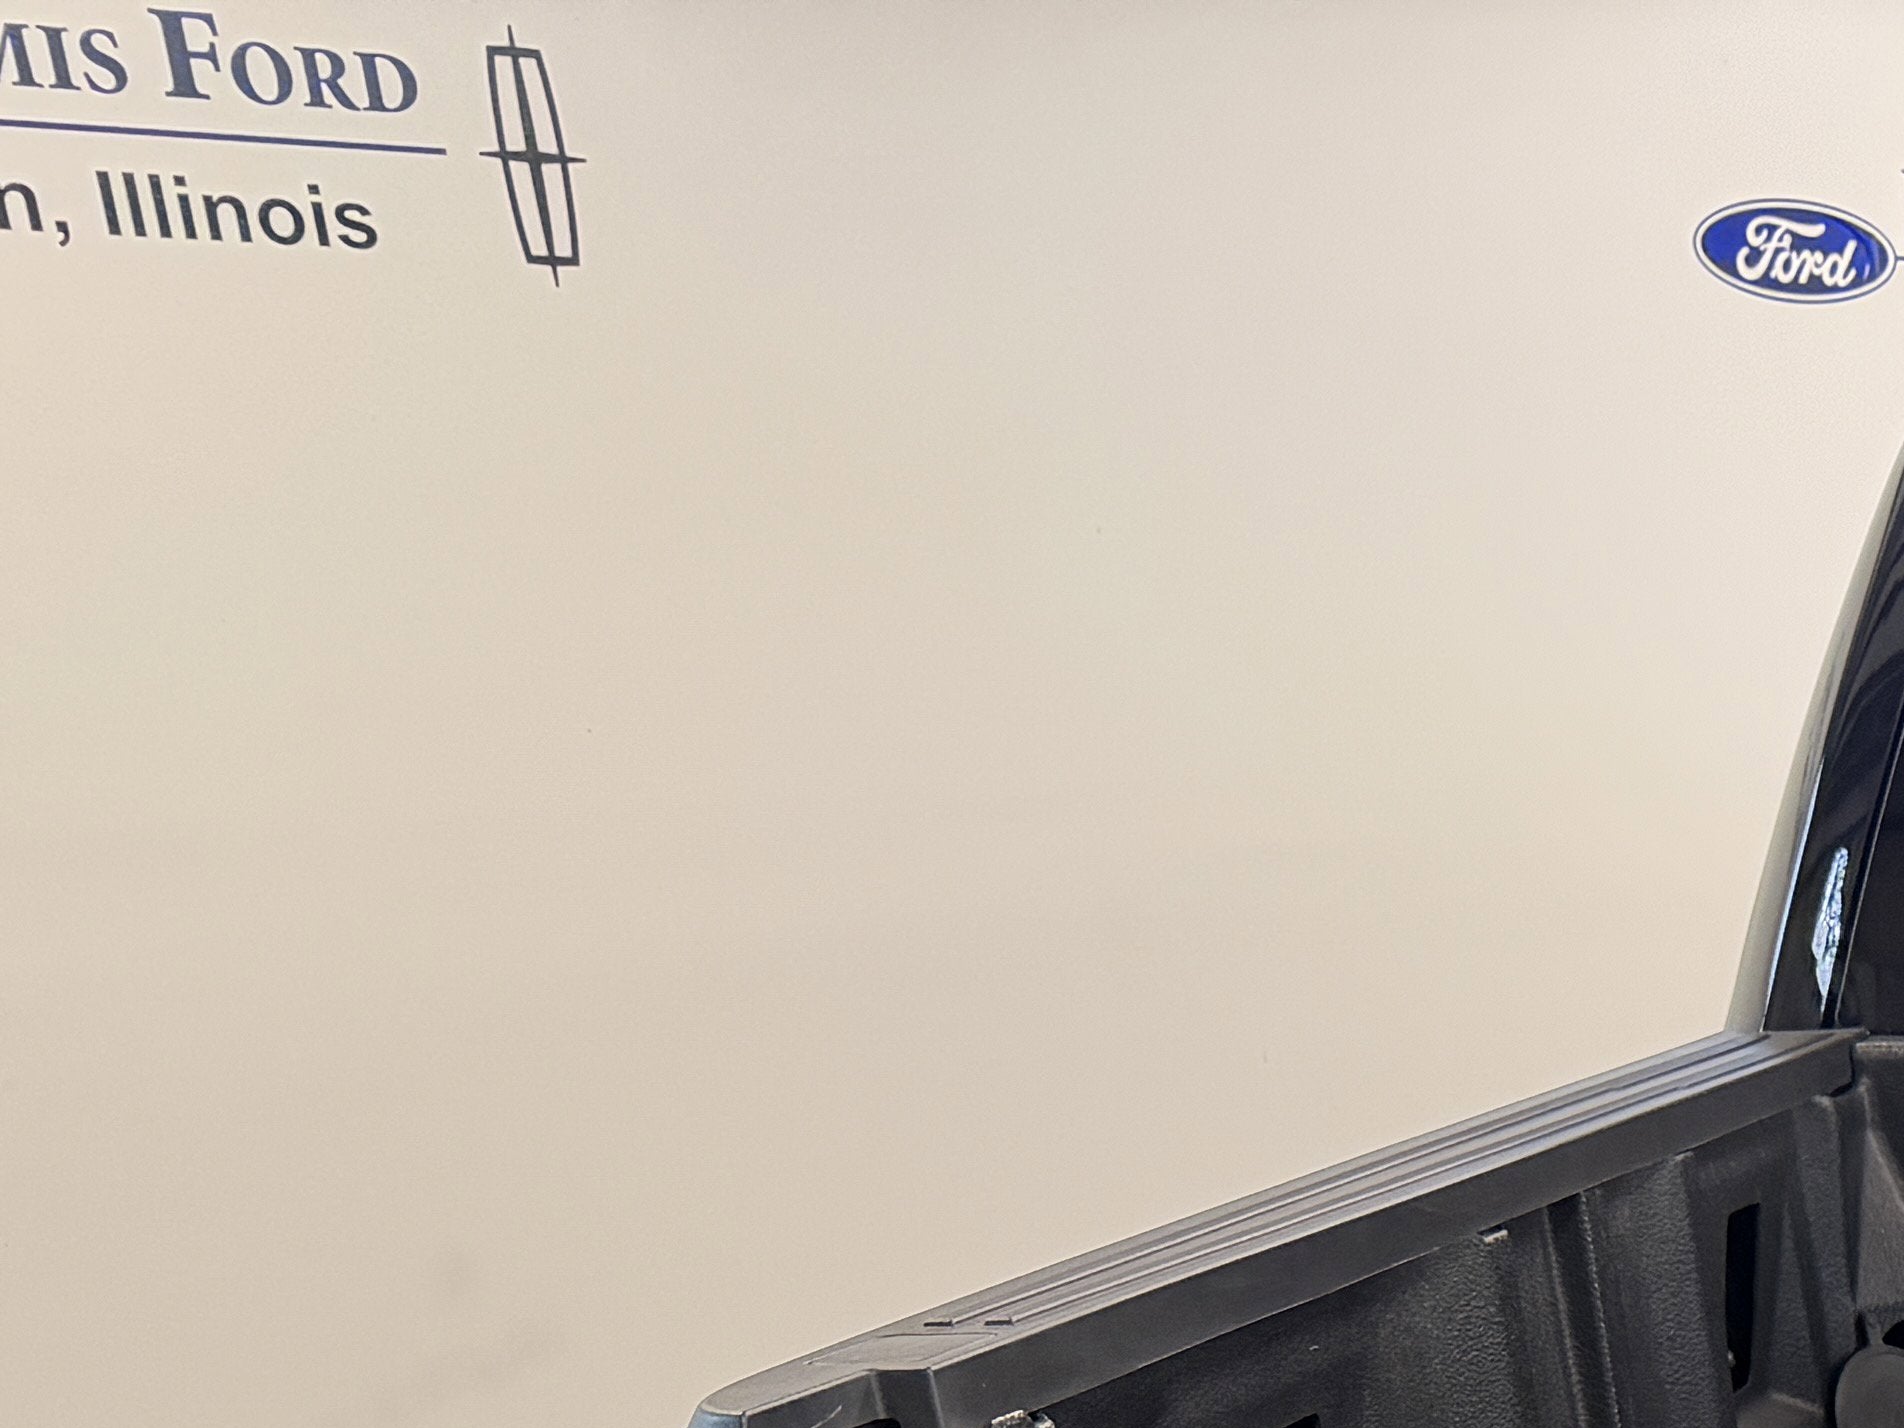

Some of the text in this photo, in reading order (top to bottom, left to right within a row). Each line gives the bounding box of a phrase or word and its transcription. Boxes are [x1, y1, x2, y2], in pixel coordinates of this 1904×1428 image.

[0, 7, 418, 113] MIS FORD
[95, 170, 378, 250] Illinois
[1736, 215, 1856, 288] Ford
